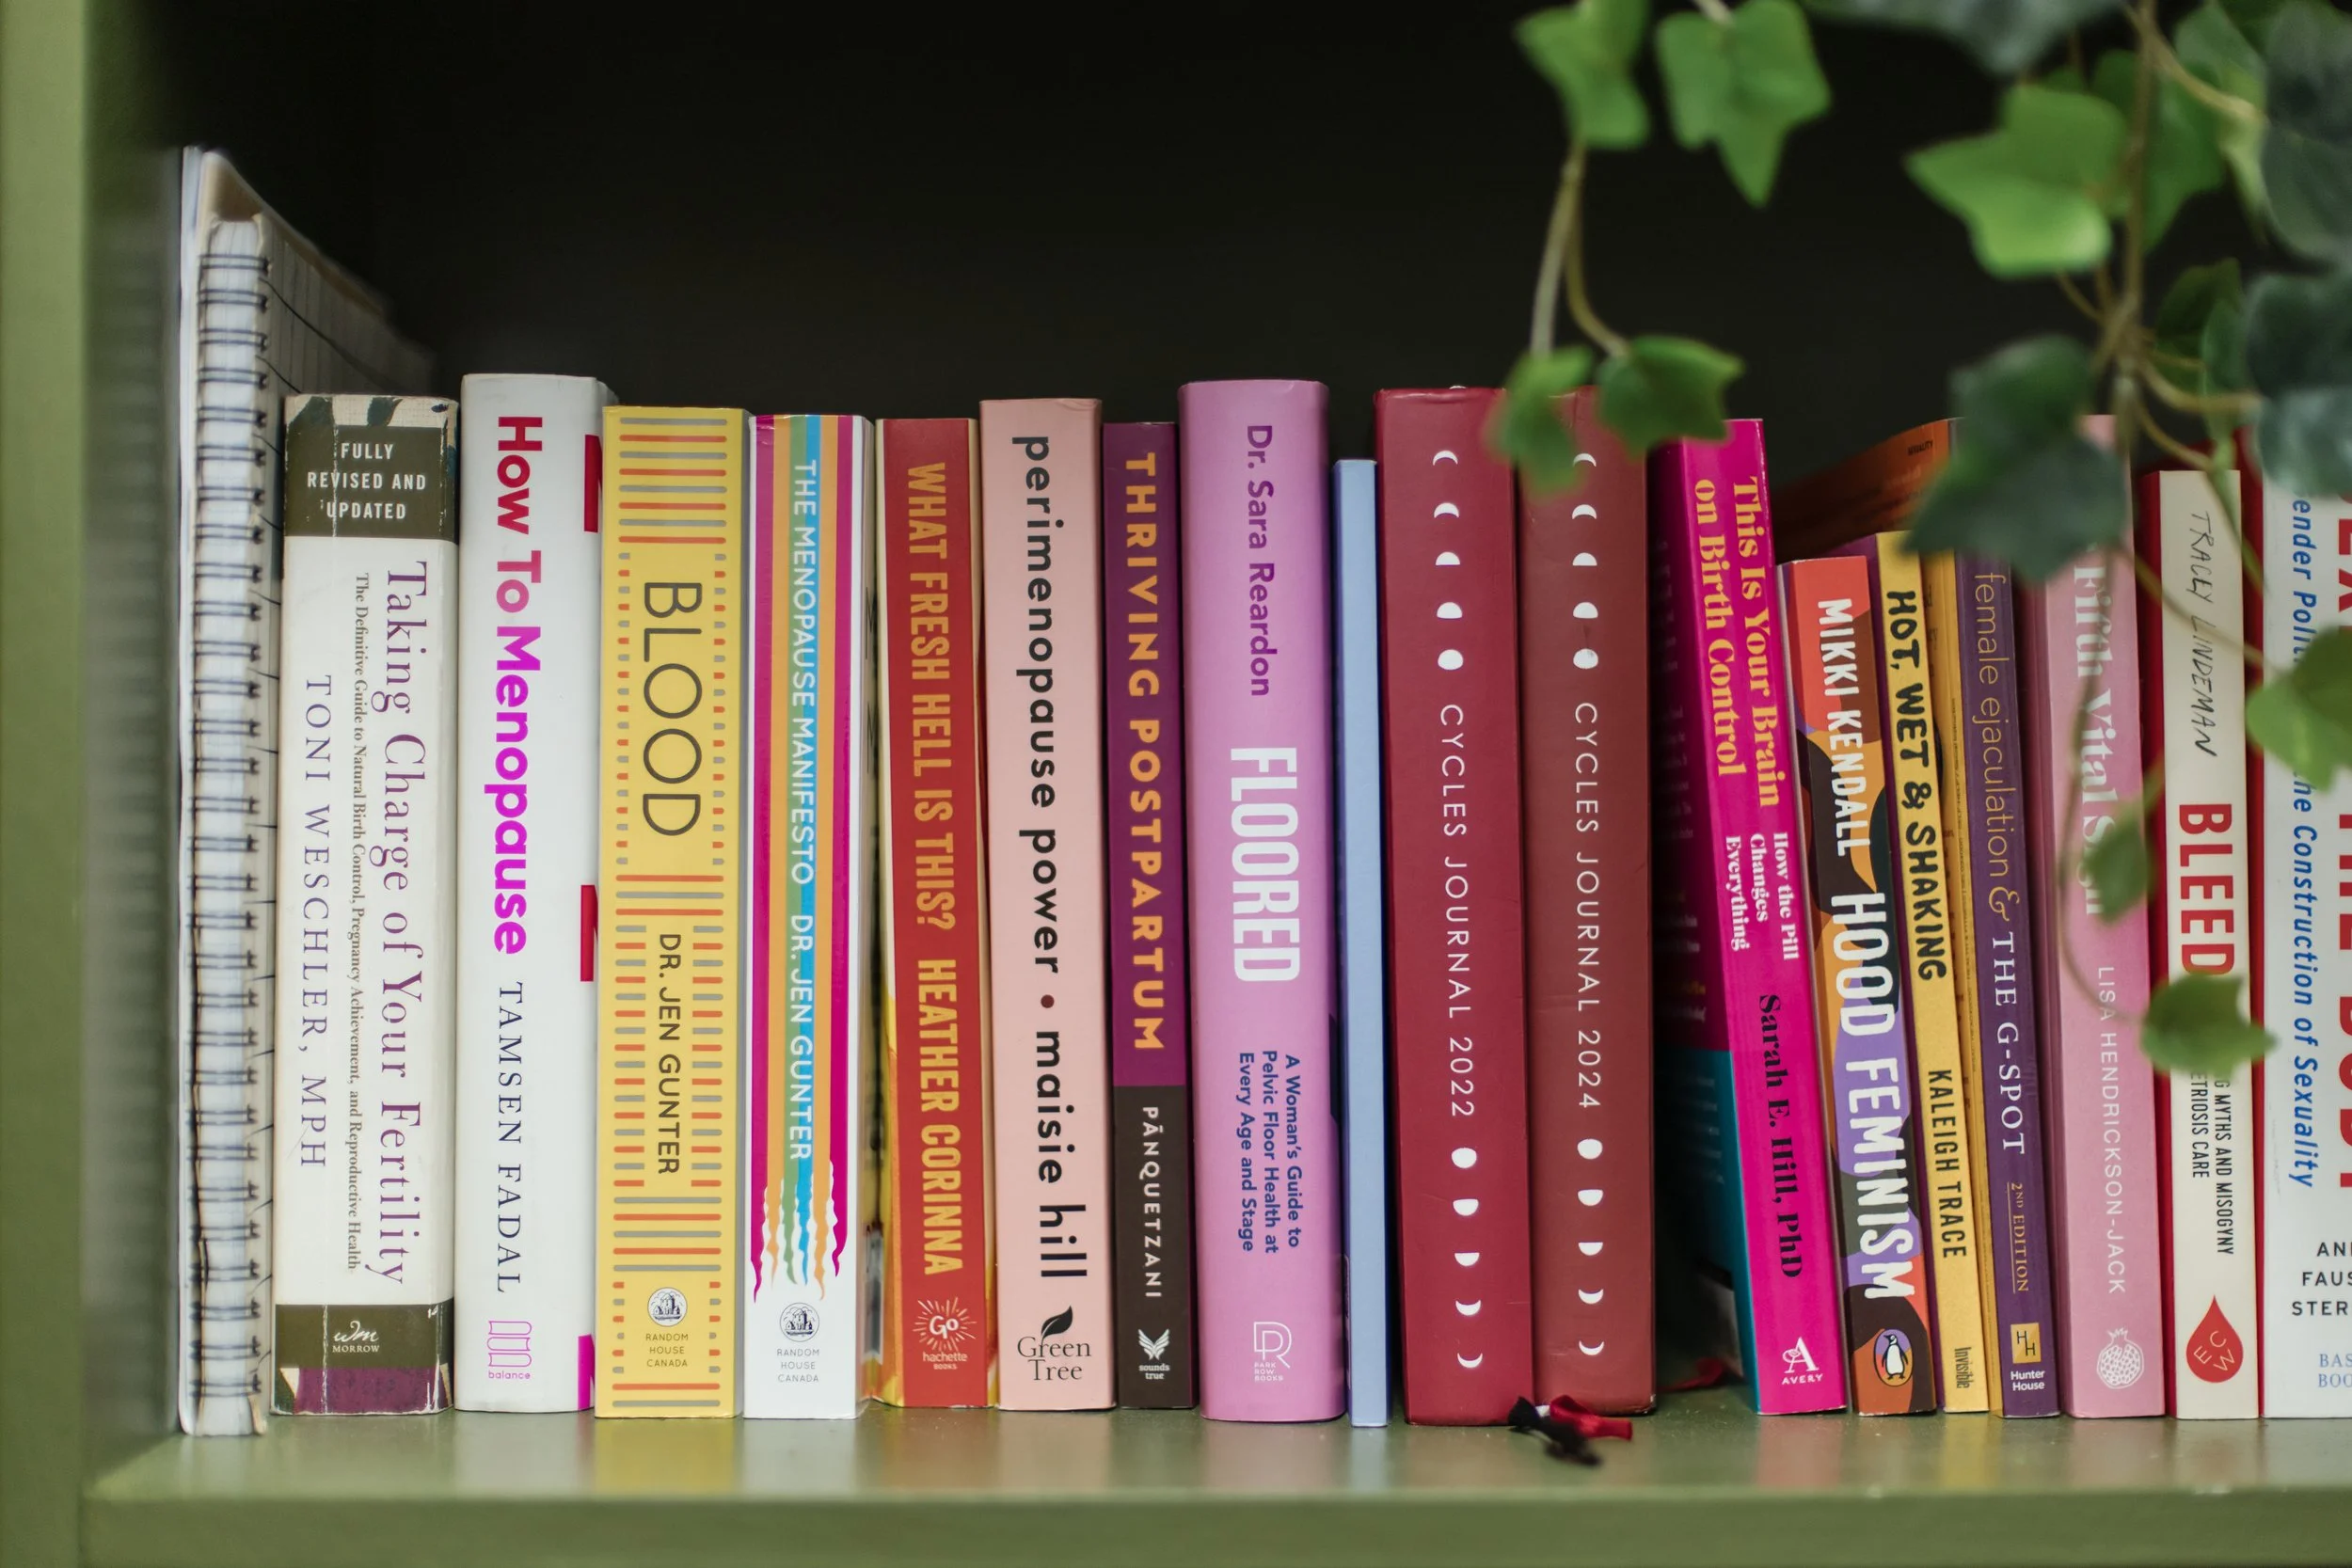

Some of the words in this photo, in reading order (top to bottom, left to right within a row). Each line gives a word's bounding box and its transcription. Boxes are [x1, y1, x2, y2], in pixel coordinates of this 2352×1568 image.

[308, 473, 383, 489] REVISED
[392, 475, 426, 490] AND
[341, 443, 394, 460] FULLY
[497, 416, 543, 534] How
[1247, 425, 1272, 468] Dr.
[326, 503, 405, 519] UPDATED
[794, 460, 817, 515] THE
[907, 462, 947, 559] WHAT
[1248, 481, 1274, 549] Sara
[1694, 479, 1718, 525] on
[1733, 476, 1765, 558] This
[1125, 452, 1159, 697] THRIVING
[2186, 511, 2214, 603] TRACEY
[2293, 499, 2317, 579] ender
[354, 572, 371, 603] The
[496, 550, 541, 612] To
[792, 527, 817, 706] MENOPAUSE
[1698, 535, 1735, 629] Birth
[1740, 566, 1766, 599] Is
[354, 606, 370, 675] Definitive
[372, 561, 428, 715] Taking
[909, 572, 950, 680] FRESH
[1011, 436, 1065, 808] perimenopause
[1249, 562, 1278, 696] Reardon
[1745, 607, 1771, 698] Your
[1818, 598, 1859, 697] MIKKI
[1886, 591, 1920, 670] HOT,
[1974, 572, 2010, 686] female
[2074, 565, 2113, 677] Fifth
[353, 678, 369, 724] Guide
[643, 582, 703, 836] BLOOD
[1708, 640, 1747, 776] Control
[2190, 615, 2218, 757] LINDEMAN
[305, 674, 332, 781] TONI
[354, 728, 364, 741] to
[912, 694, 952, 777] HELL
[1750, 705, 1786, 806] Brain
[1895, 683, 1929, 768] WET
[2081, 688, 2118, 805] Vital
[353, 745, 368, 799] Natural
[485, 626, 541, 954] Menopause
[791, 718, 816, 884] MANIFESTO
[1440, 704, 1467, 836] CYCLES
[1575, 702, 1598, 832] CYCLES
[1826, 709, 1870, 856] KENDALL
[1901, 781, 1932, 810] &
[1972, 697, 2016, 878] ejaculation
[2293, 772, 2317, 812] he
[352, 802, 367, 840] Birth
[369, 734, 426, 891] Charge
[914, 790, 953, 821] IS
[350, 843, 366, 904] Control,
[914, 832, 956, 930] THIS?
[1129, 720, 1164, 1049] POSTPARTUM
[1231, 747, 1300, 982] FLOORED
[1725, 835, 1751, 952] Everything
[1750, 833, 1770, 923] Changes
[1773, 832, 1789, 882] How
[2179, 803, 2234, 975] BLEED
[298, 804, 330, 1052] WESCHLER,
[382, 911, 423, 958] of
[790, 914, 813, 958] DR.
[1019, 829, 1058, 974] power
[1444, 856, 1471, 1019] JOURNAL
[1576, 851, 1599, 1011] JOURNAL
[1777, 883, 1795, 919] the
[1905, 821, 1947, 981] SHAKING
[1989, 886, 2020, 922] &
[2293, 825, 2318, 1006] Construction
[346, 907, 365, 982] Pregnancy
[659, 934, 680, 978] DR.
[1781, 924, 1799, 960] Pill
[1831, 893, 1896, 1037] HOOD
[1993, 931, 2017, 1006] THE
[381, 971, 423, 1078] Your
[659, 987, 680, 1040] JEN
[789, 966, 813, 1023] JEN
[2098, 966, 2116, 1021] LISA
[347, 986, 365, 1084] Achievement,
[499, 982, 523, 1144] TAMSEN
[917, 959, 959, 1112] HEATHER
[1285, 1054, 1300, 1069] A
[1578, 1030, 1600, 1108] 2024
[1759, 994, 1788, 1088] Sarah
[2294, 1018, 2318, 1047] of
[349, 1090, 364, 1117] and
[658, 1053, 680, 1175] GUNTER
[789, 1034, 812, 1160] GUNTER
[1035, 1031, 1075, 1184] maisie
[1236, 1053, 1254, 1106] Every
[1263, 1051, 1278, 1104] Pelvic
[1449, 1037, 1474, 1117] 2022
[1768, 1099, 1789, 1127] E.
[1996, 1022, 2026, 1155] G-SPOT
[300, 1075, 326, 1167] MPH
[1236, 1112, 1255, 1150] Age
[1263, 1111, 1279, 1160] Floor
[1929, 1069, 1960, 1174] KALEIGH
[2215, 1094, 2232, 1141] MYTHS
[2288, 1055, 2319, 1188] Sexuality
[344, 1118, 363, 1217] Reproductive
[365, 1101, 421, 1284] Fertility
[1241, 1157, 1257, 1191] and
[1264, 1167, 1279, 1227] Health
[1287, 1166, 1302, 1222] Guide
[1771, 1137, 1799, 1203] Hill,
[1846, 1058, 1915, 1299] FEMINISM
[2101, 1032, 2126, 1294] HENDRICKSON-JACK
[2192, 1141, 2209, 1178] CARE
[2216, 1148, 2233, 1176] AND
[498, 1164, 522, 1292] FADAL
[920, 1123, 964, 1275] CORINNA
[1139, 1107, 1163, 1297] PĀNQUETZANI
[1238, 1197, 1257, 1252] Stage
[1937, 1181, 1966, 1259] TRACE
[2216, 1182, 2234, 1256] MISOGYNY
[347, 1221, 362, 1270] Health
[1039, 1204, 1088, 1276] hill
[1265, 1234, 1278, 1253] at
[1289, 1227, 1301, 1248] to
[1777, 1212, 1803, 1277] PhD
[2012, 1214, 2028, 1292] EDITION
[2316, 1242, 2352, 1257] AN
[488, 1370, 531, 1380] balance
[645, 1333, 689, 1341] RANDOM
[646, 1358, 688, 1367] CANADA
[649, 1346, 685, 1354] HOUSE
[777, 1348, 819, 1356] RANDOM
[781, 1361, 816, 1370] HOUSE
[923, 1352, 967, 1362] hachette
[1017, 1336, 1091, 1357] Green
[1028, 1359, 1082, 1380] Tree
[1954, 1347, 1972, 1389] Invisible
[778, 1374, 818, 1383] CANADA
[1781, 1372, 1823, 1385] AVERY
[2010, 1370, 2045, 1381] Hunter
[2012, 1381, 2044, 1391] House
